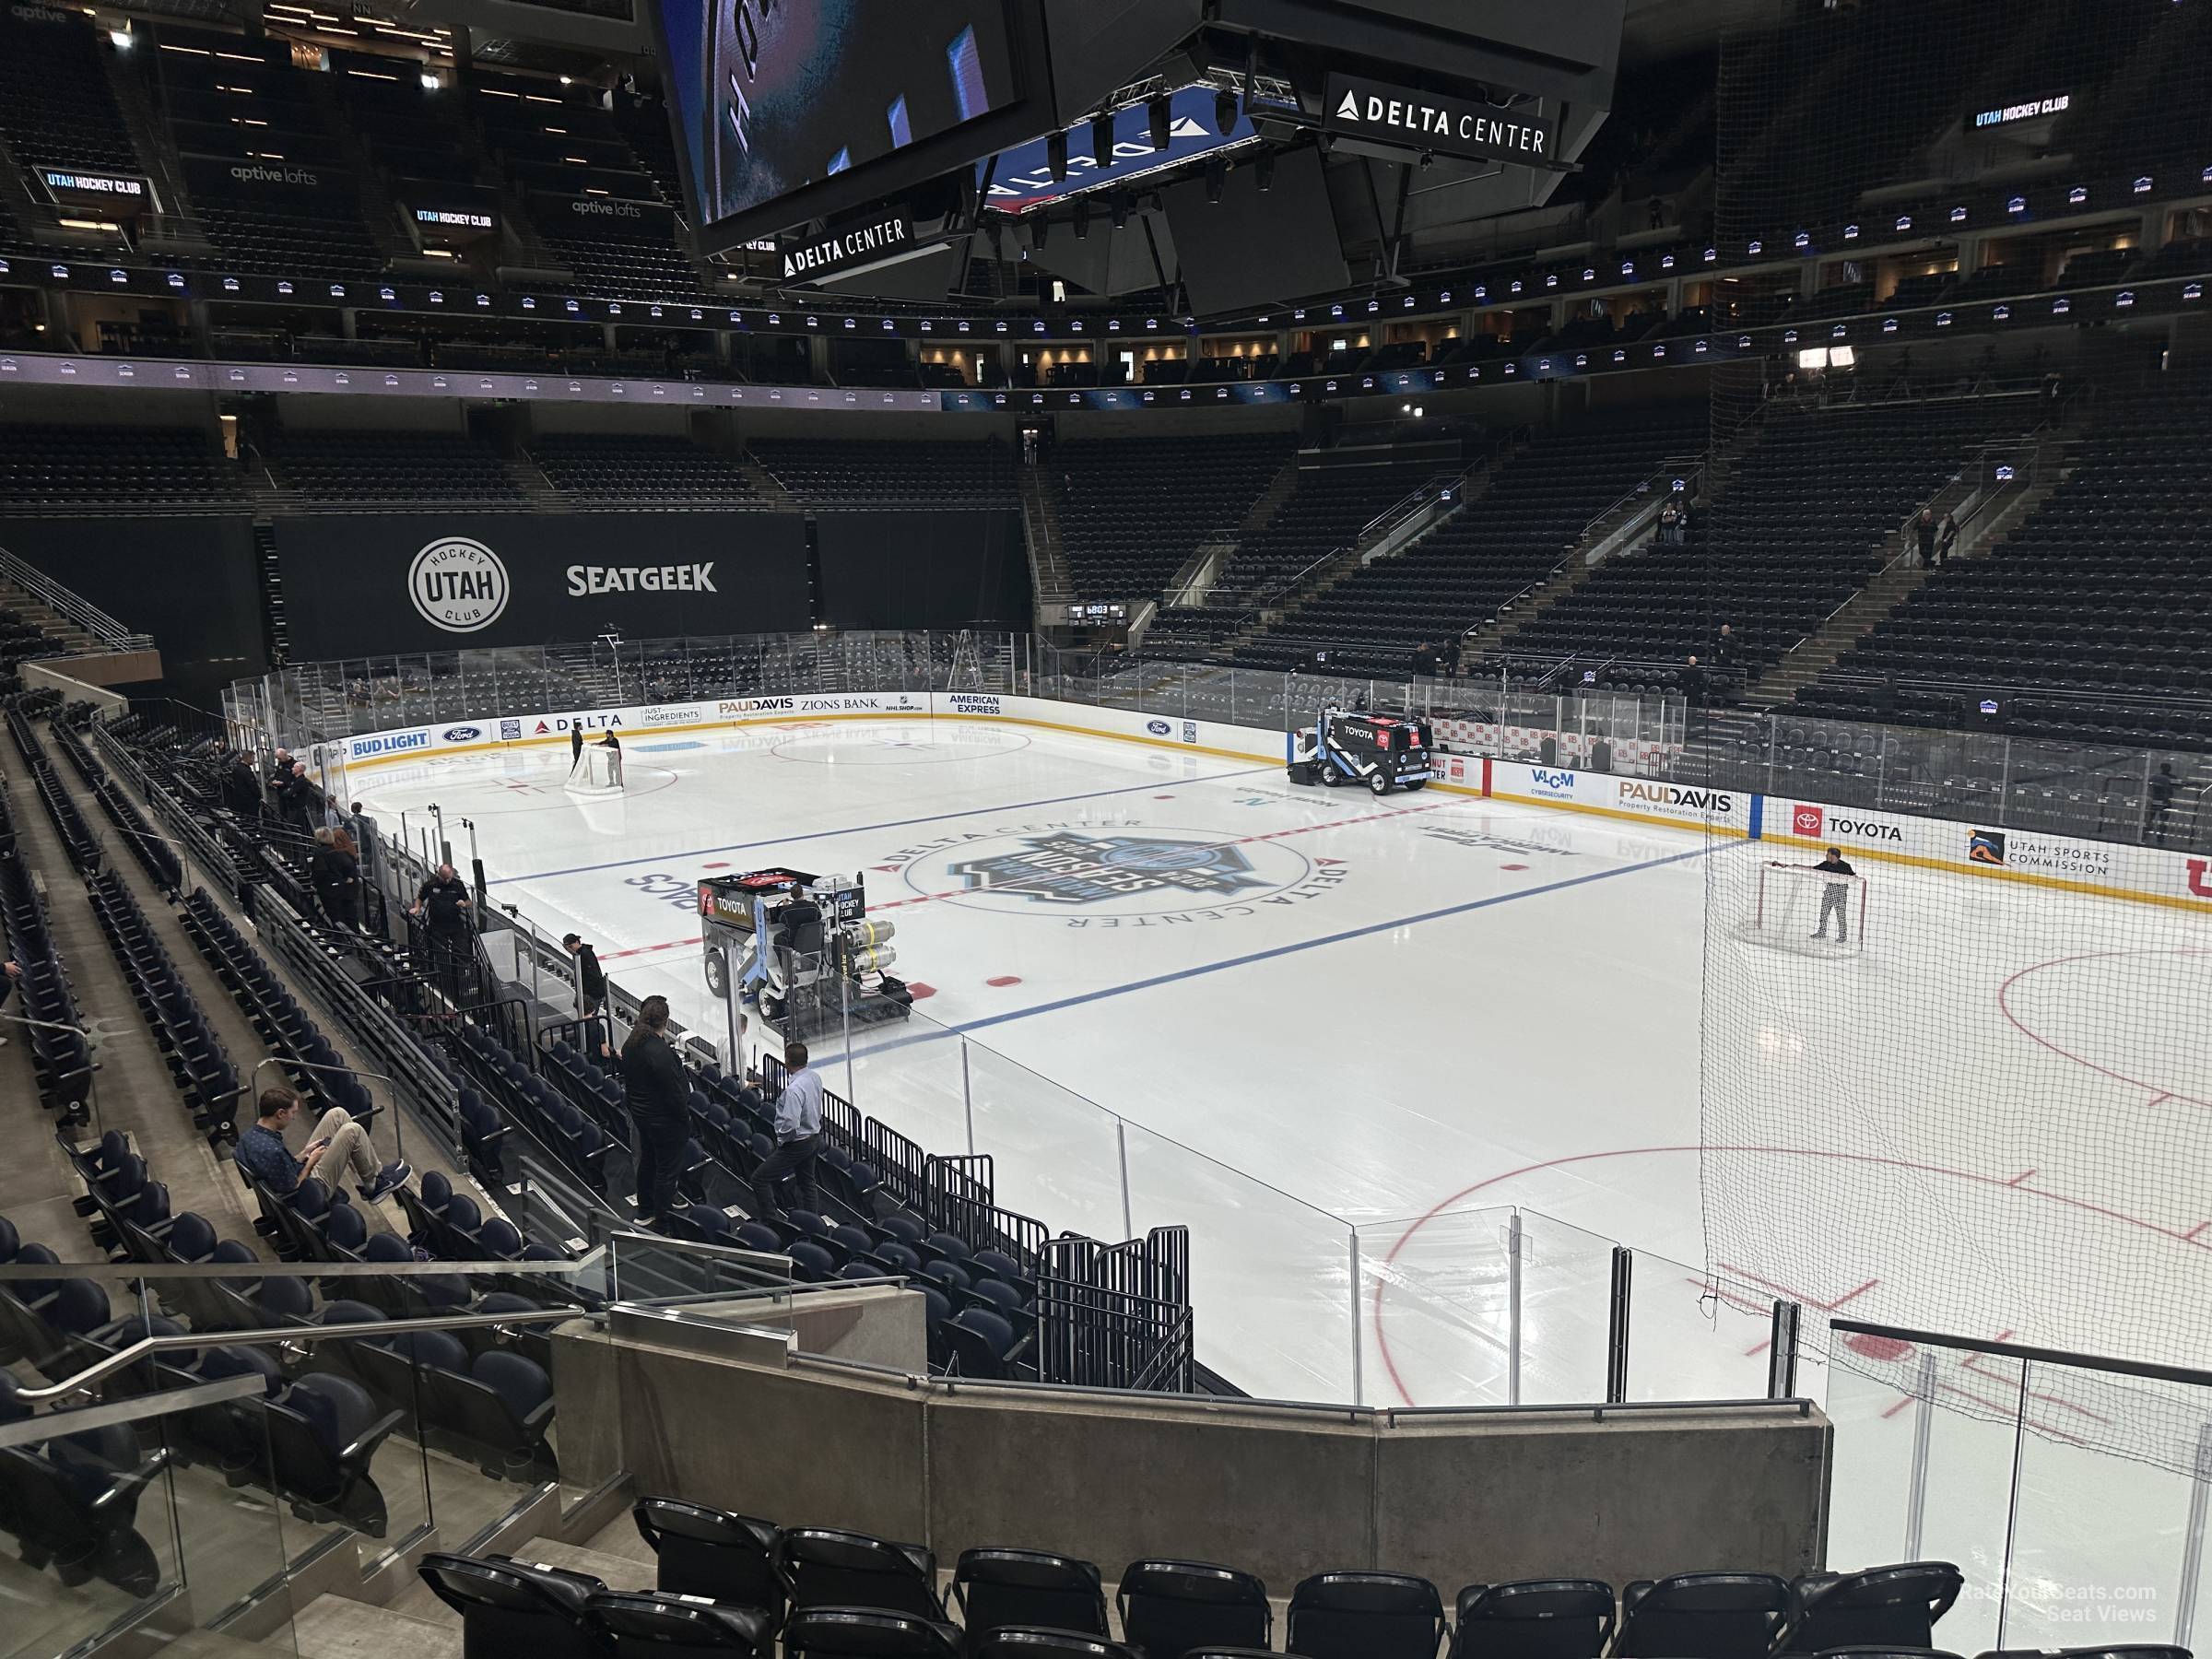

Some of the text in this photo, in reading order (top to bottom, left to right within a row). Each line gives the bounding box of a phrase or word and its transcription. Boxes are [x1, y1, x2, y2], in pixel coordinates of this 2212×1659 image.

[1975, 95, 2069, 127] UTAH HOCKEY CLUB
[1367, 96, 1544, 154] DELTA CENTER
[47, 173, 141, 194] UTAH HOCKEY CLUB
[230, 166, 318, 185] aptive lofts
[417, 209, 492, 227] UTAH HOCKEY CLUB
[571, 201, 641, 218] aptive lofts
[758, 241, 775, 252] CLUB
[794, 218, 905, 271] DELTA CENTER
[429, 548, 486, 567] HOCKEY
[425, 570, 494, 603] UTAH
[566, 561, 718, 597] SEATGEEK
[445, 608, 481, 622] CLUB
[801, 698, 878, 711] ZIONS BANK
[949, 694, 1000, 706] AMERICAN
[958, 704, 1001, 715] EXPRESS
[644, 707, 662, 715] JUST
[645, 711, 700, 722] INGREDIENTS
[1344, 725, 1374, 741] TOYOTA
[353, 740, 382, 756] BUD
[384, 732, 428, 750] LIGHT
[1531, 788, 1573, 799] CYBERSECURITY
[1619, 800, 1651, 812] Property
[1653, 806, 1698, 818] Restoration
[1829, 818, 1902, 841] TOYOTA
[883, 819, 1141, 863] DELTA CENTER
[2009, 840, 2110, 864] UTAH SPORTS
[1012, 851, 1165, 891] SEASON
[2008, 853, 2109, 876] COMMISSION
[717, 897, 747, 916] TOYOTA
[1066, 868, 1347, 928] DELTA CENTER
[840, 909, 853, 918] LUB
